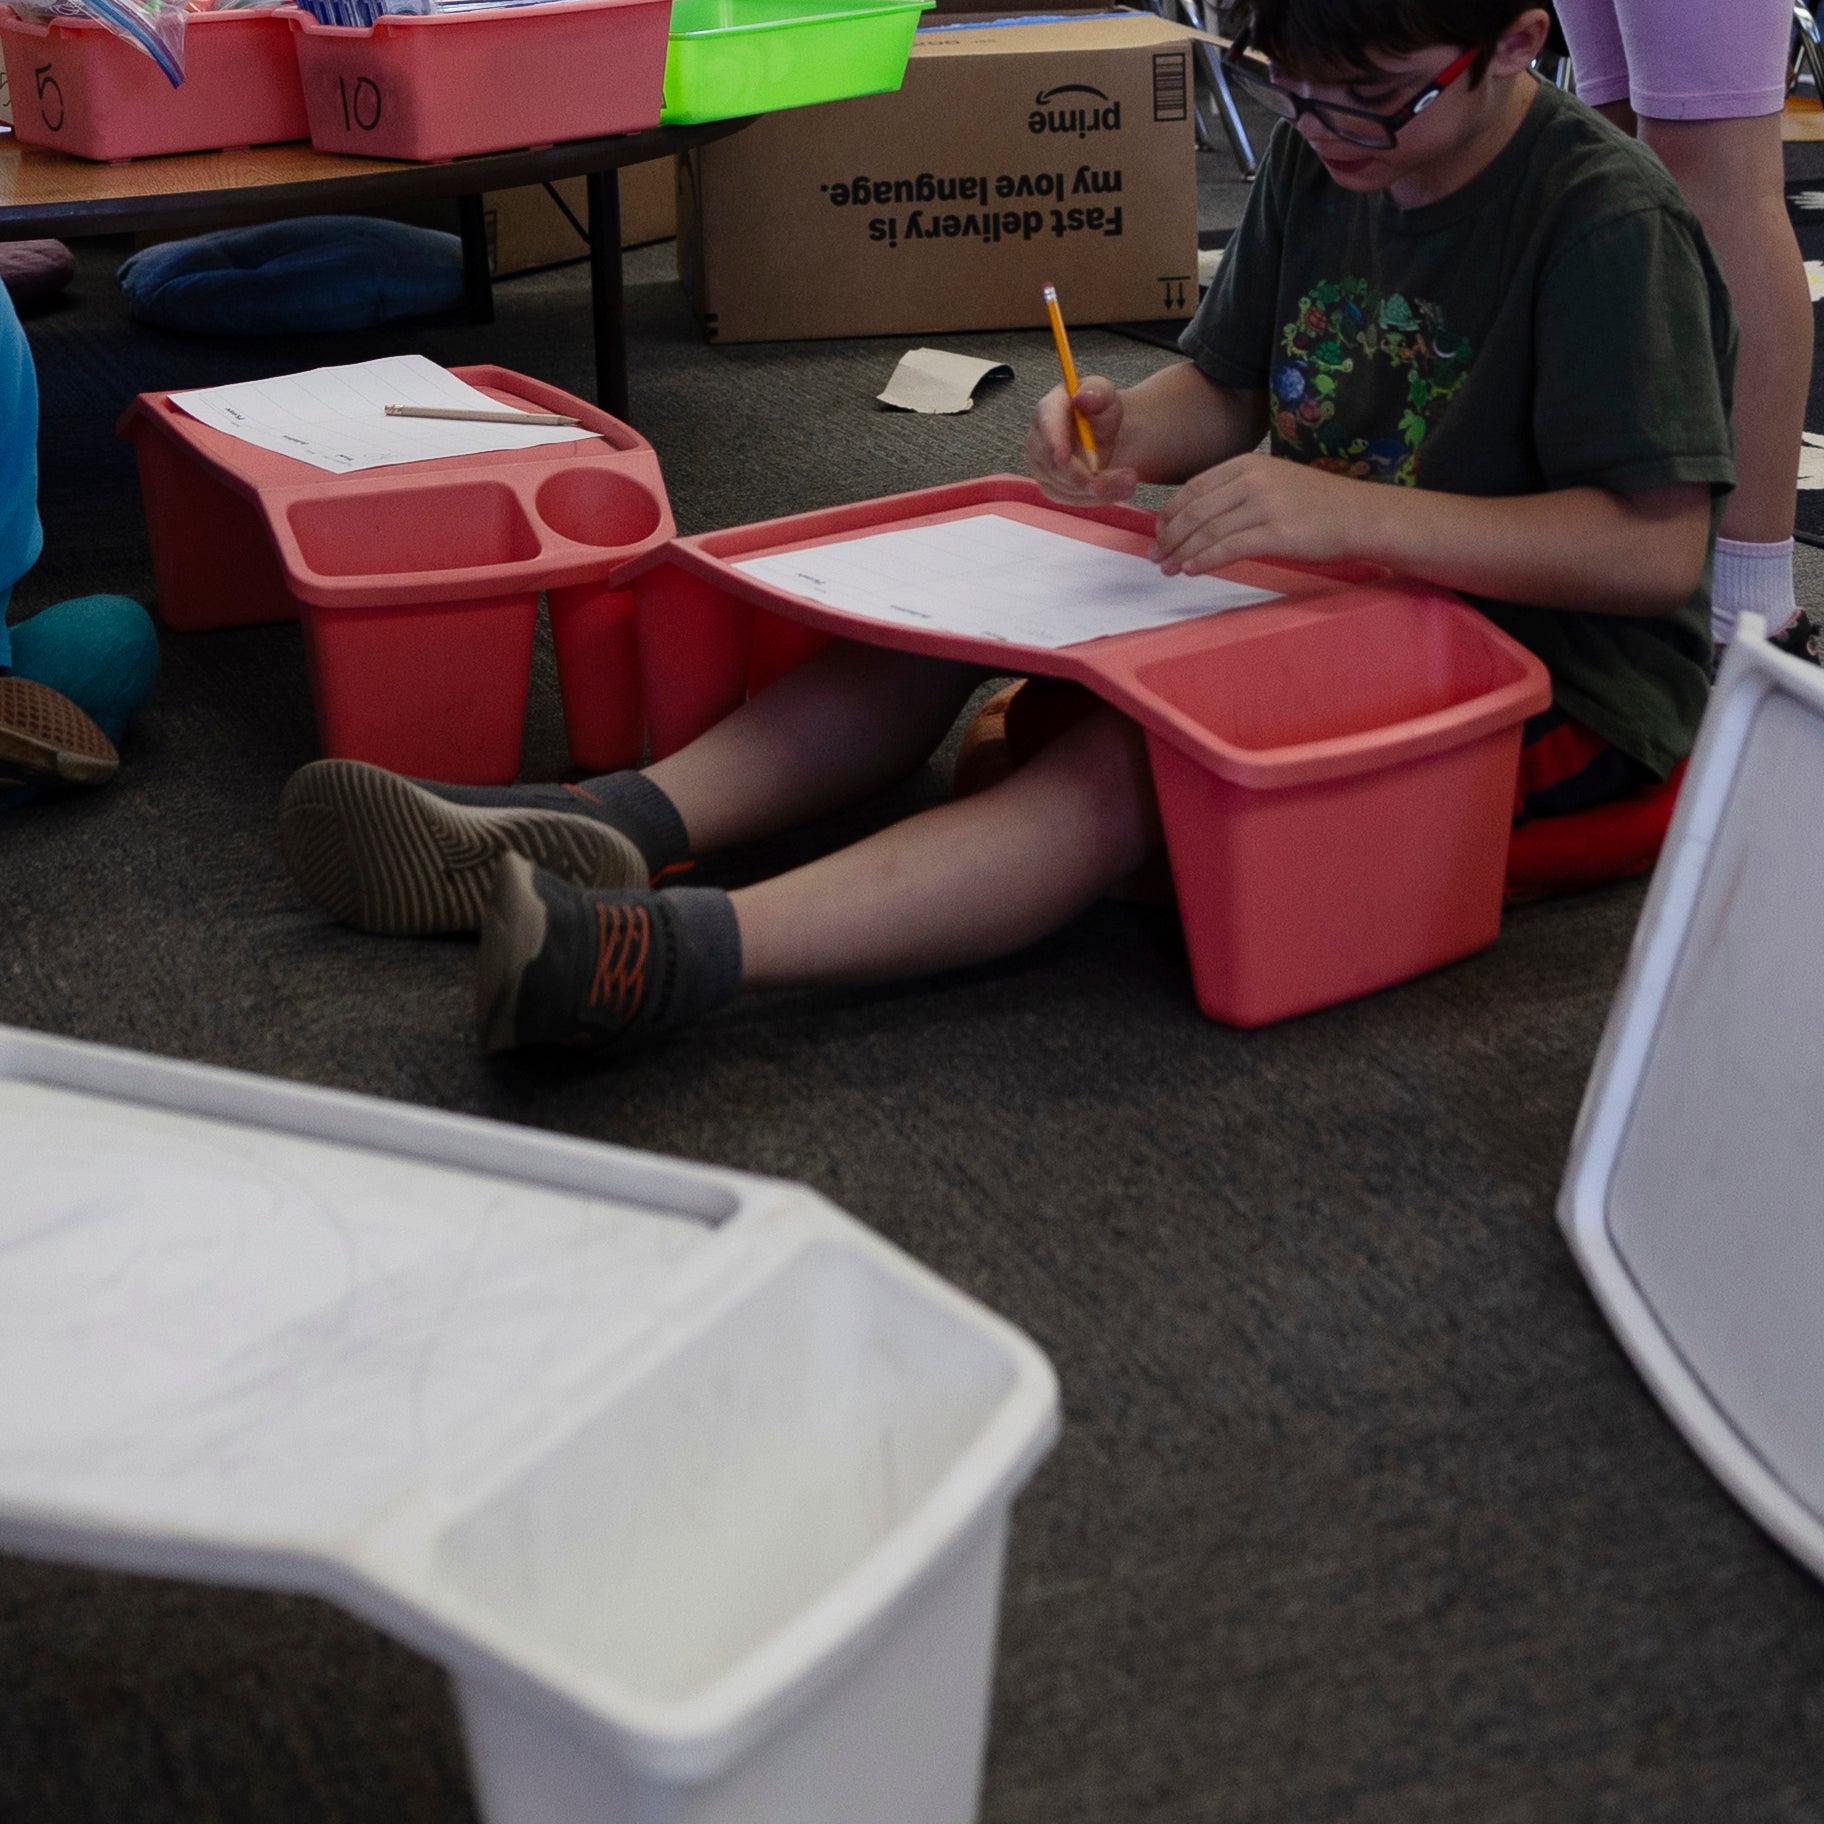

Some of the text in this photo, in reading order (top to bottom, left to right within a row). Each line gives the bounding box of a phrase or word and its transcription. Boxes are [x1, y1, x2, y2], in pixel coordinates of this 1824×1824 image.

[35, 63, 64, 132] 5
[339, 75, 381, 131] 10
[1028, 102, 1121, 139] prime
[821, 166, 1122, 206] my love language.
[868, 206, 1123, 248] Fast delivery is
